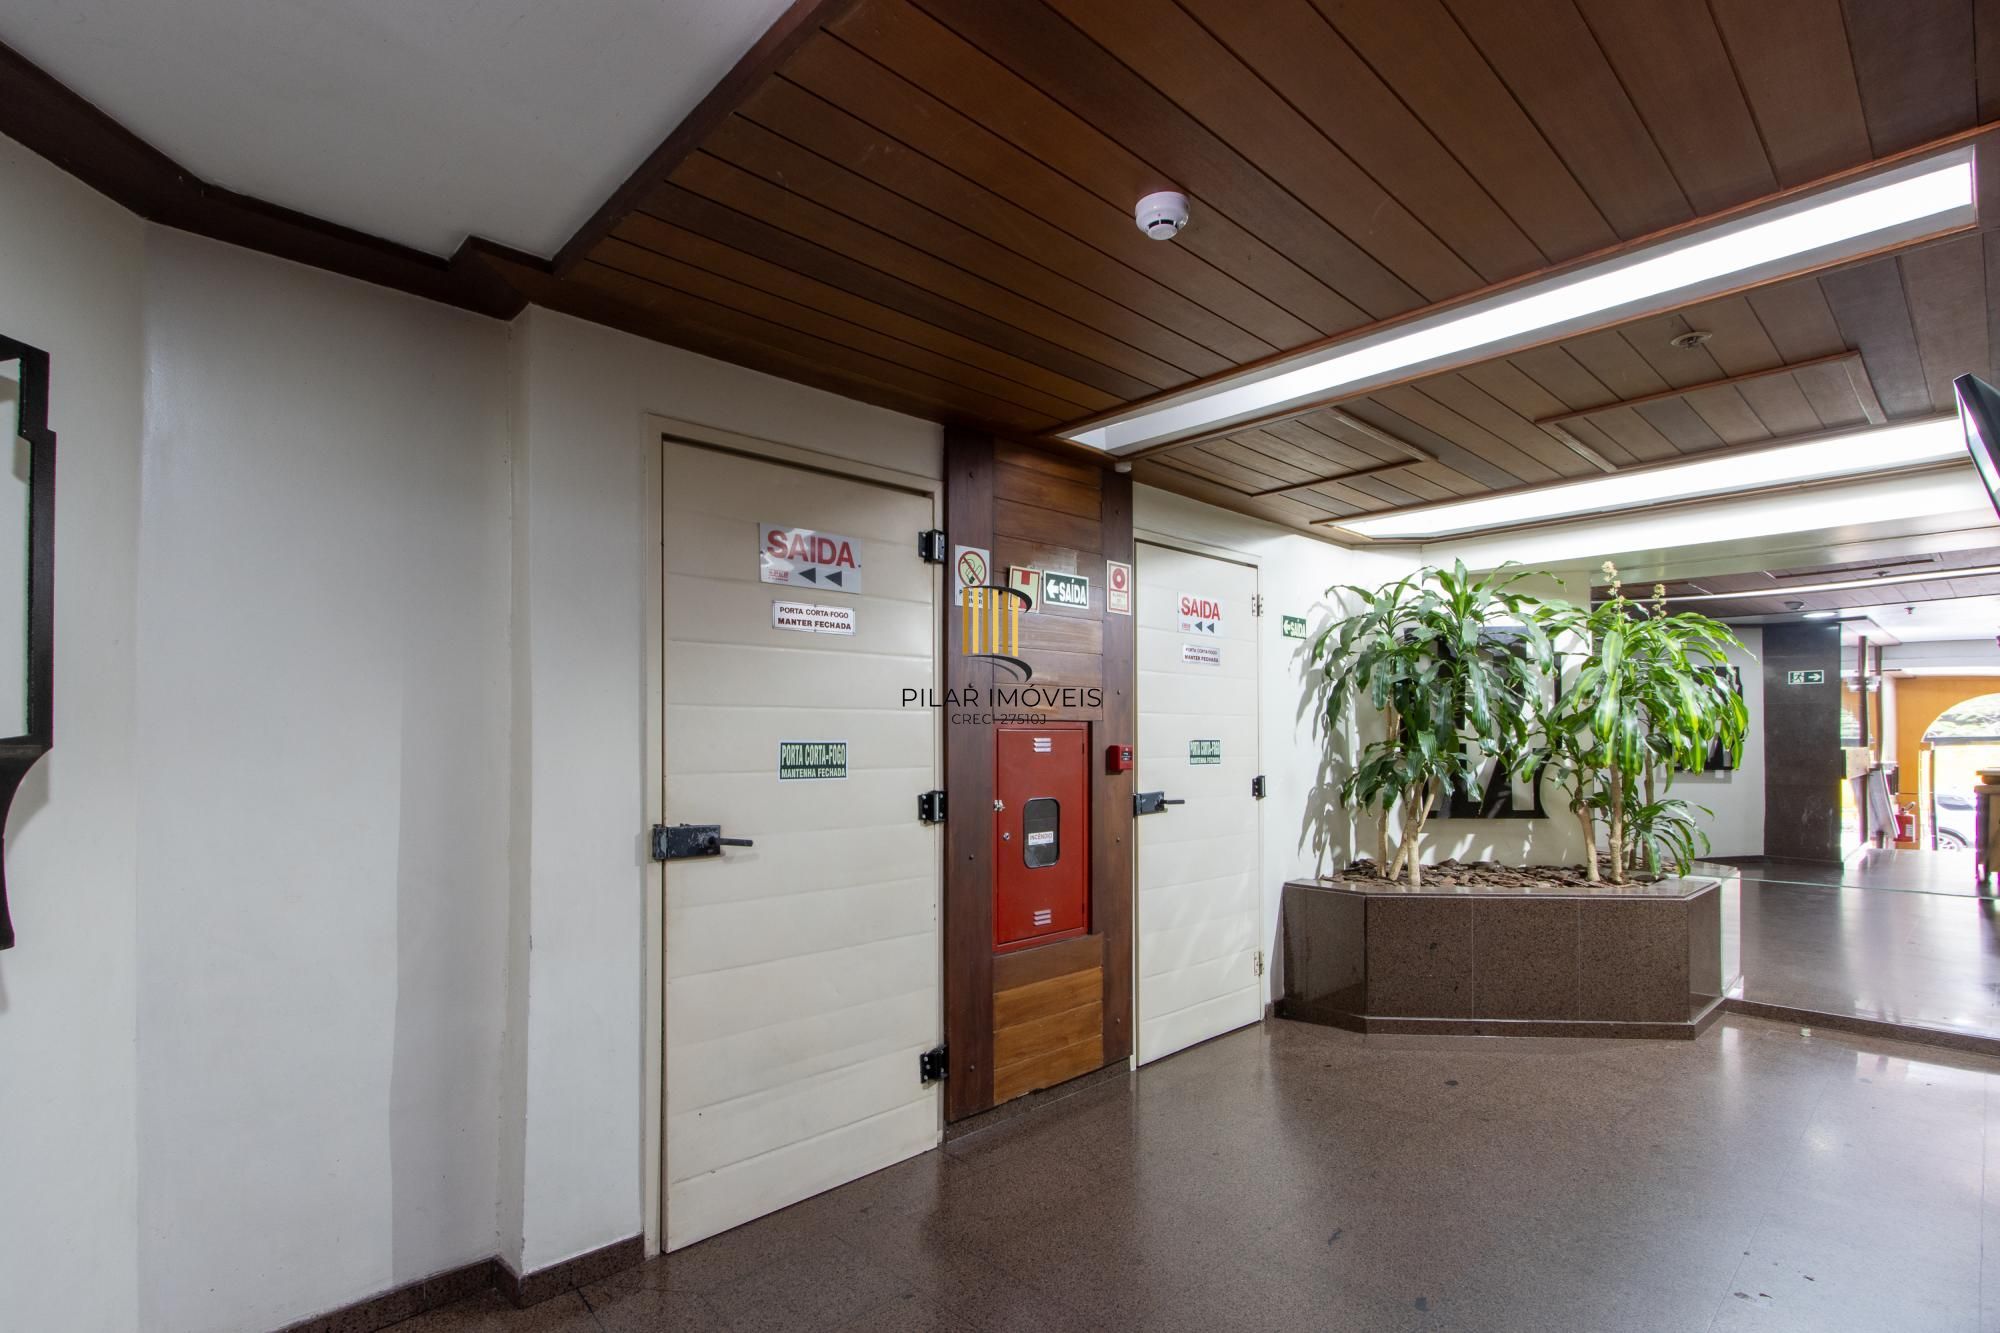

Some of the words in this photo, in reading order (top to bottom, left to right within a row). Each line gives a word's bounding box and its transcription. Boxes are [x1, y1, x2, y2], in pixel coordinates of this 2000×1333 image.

[767, 530, 855, 569] SAIDA
[1059, 578, 1087, 605] SAÍDA
[779, 606, 804, 615] PORTA
[806, 609, 829, 617] CORTA
[830, 611, 849, 619] FOGO
[1181, 596, 1221, 621] SAIDA
[777, 617, 813, 627] MANTER
[814, 620, 852, 630] FECHADA
[781, 744, 804, 766] PORTA
[804, 744, 846, 766] CORTA-FOGO
[781, 768, 816, 778] MANTENHA
[817, 767, 846, 777] FECHADA
